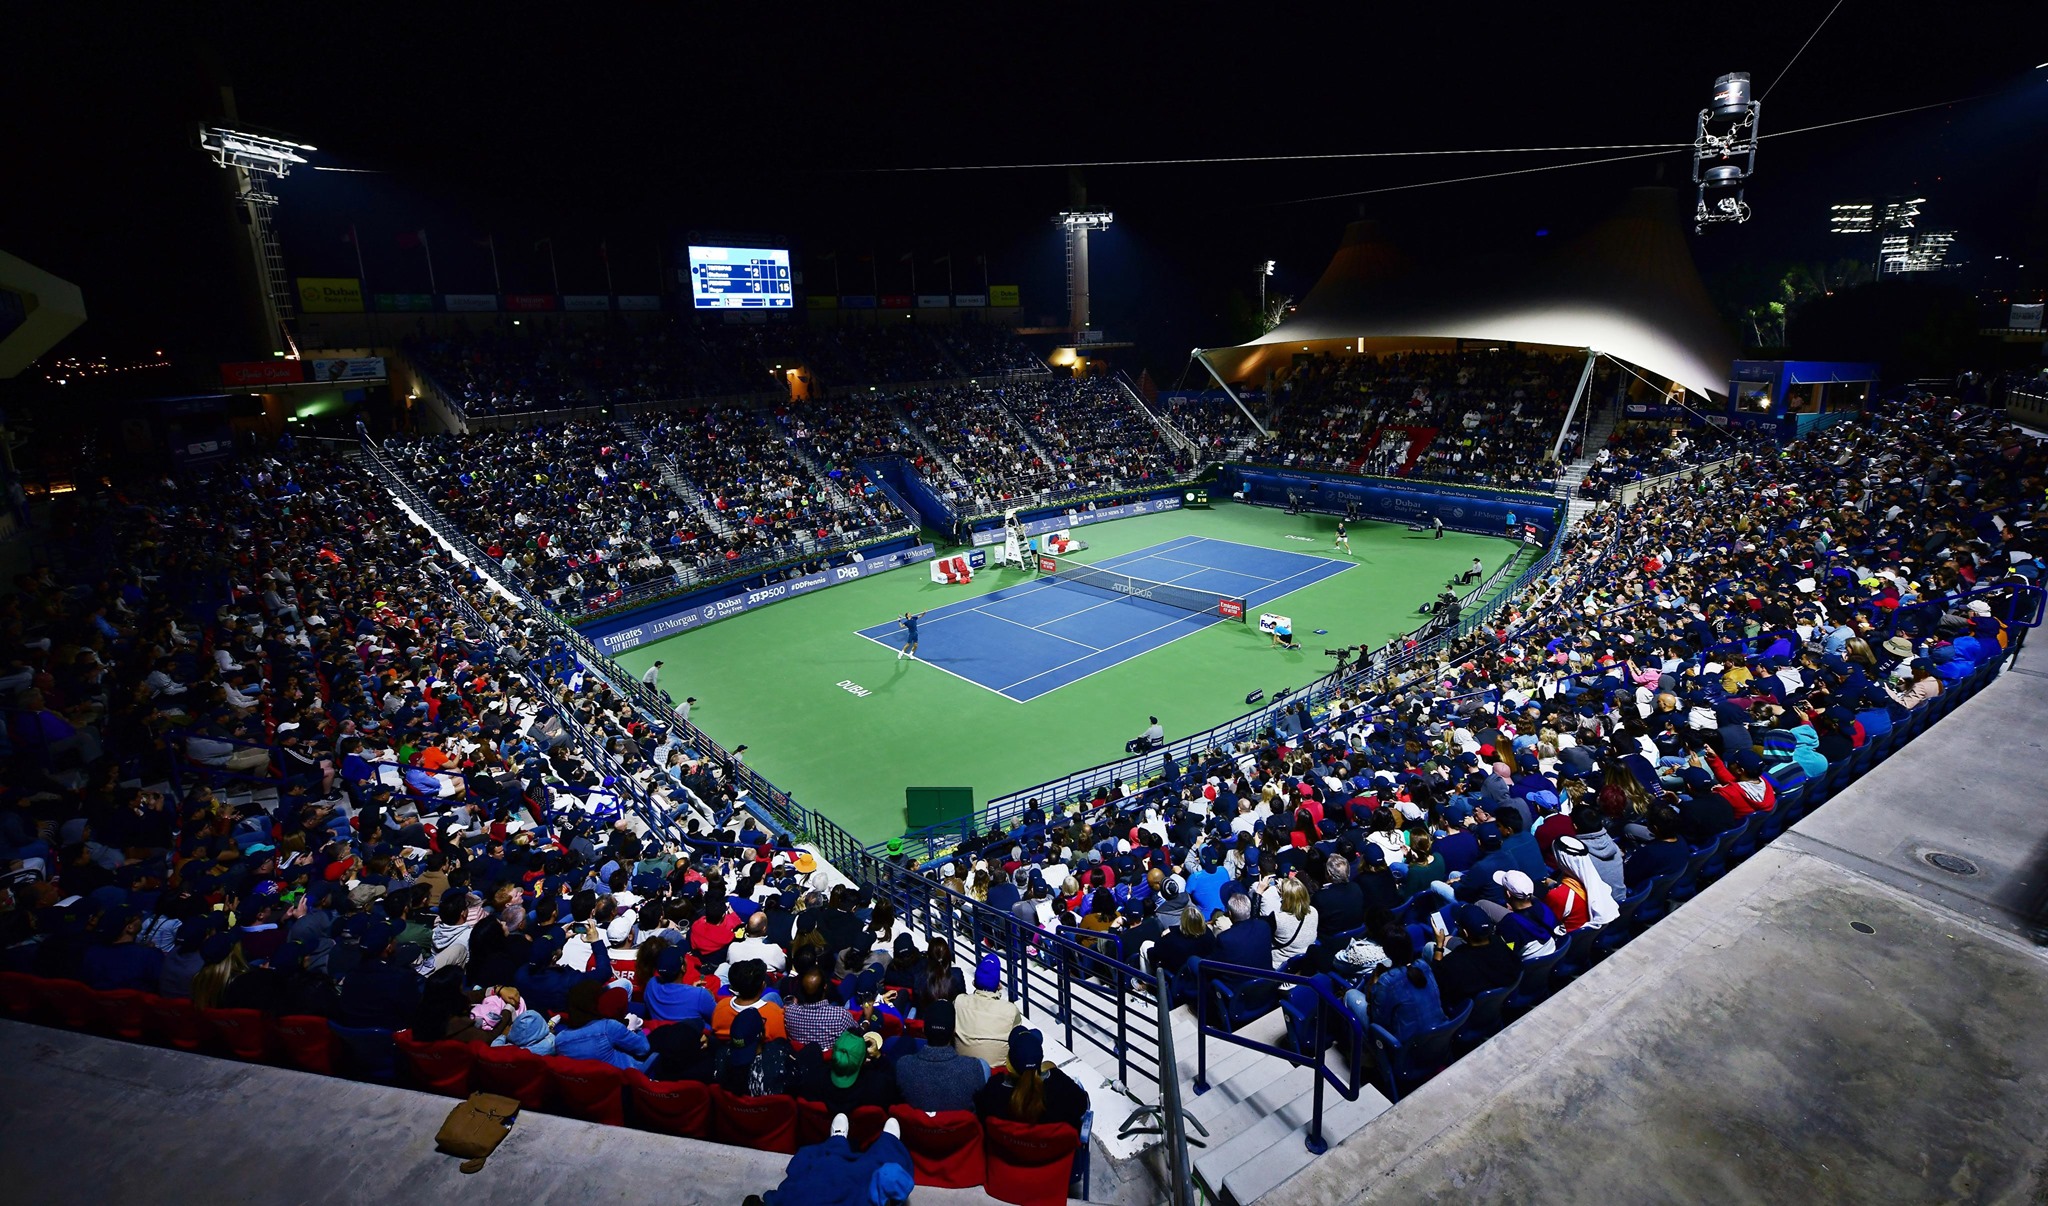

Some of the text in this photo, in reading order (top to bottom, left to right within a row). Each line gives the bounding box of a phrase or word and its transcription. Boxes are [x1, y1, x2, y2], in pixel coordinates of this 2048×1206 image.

[752, 268, 787, 278] 2 0
[323, 287, 359, 296] Dubai
[754, 283, 761, 292] 3
[1338, 491, 1362, 500] Dubai
[1395, 499, 1421, 508] Dubai
[1284, 534, 1315, 542] DUBAI
[903, 547, 934, 560] J.P.Morgan
[836, 566, 860, 579] DXB
[791, 577, 826, 591] #DDFtennis
[1111, 582, 1153, 598] ATP TOUR
[717, 598, 742, 611] Dubai
[719, 605, 743, 616] Duty Free
[1220, 601, 1240, 611] Emirates
[652, 613, 698, 634] J.P.Morgan
[603, 627, 643, 647] Emirates
[612, 637, 640, 653] FLY BETTER
[835, 680, 873, 698] DUBAI
